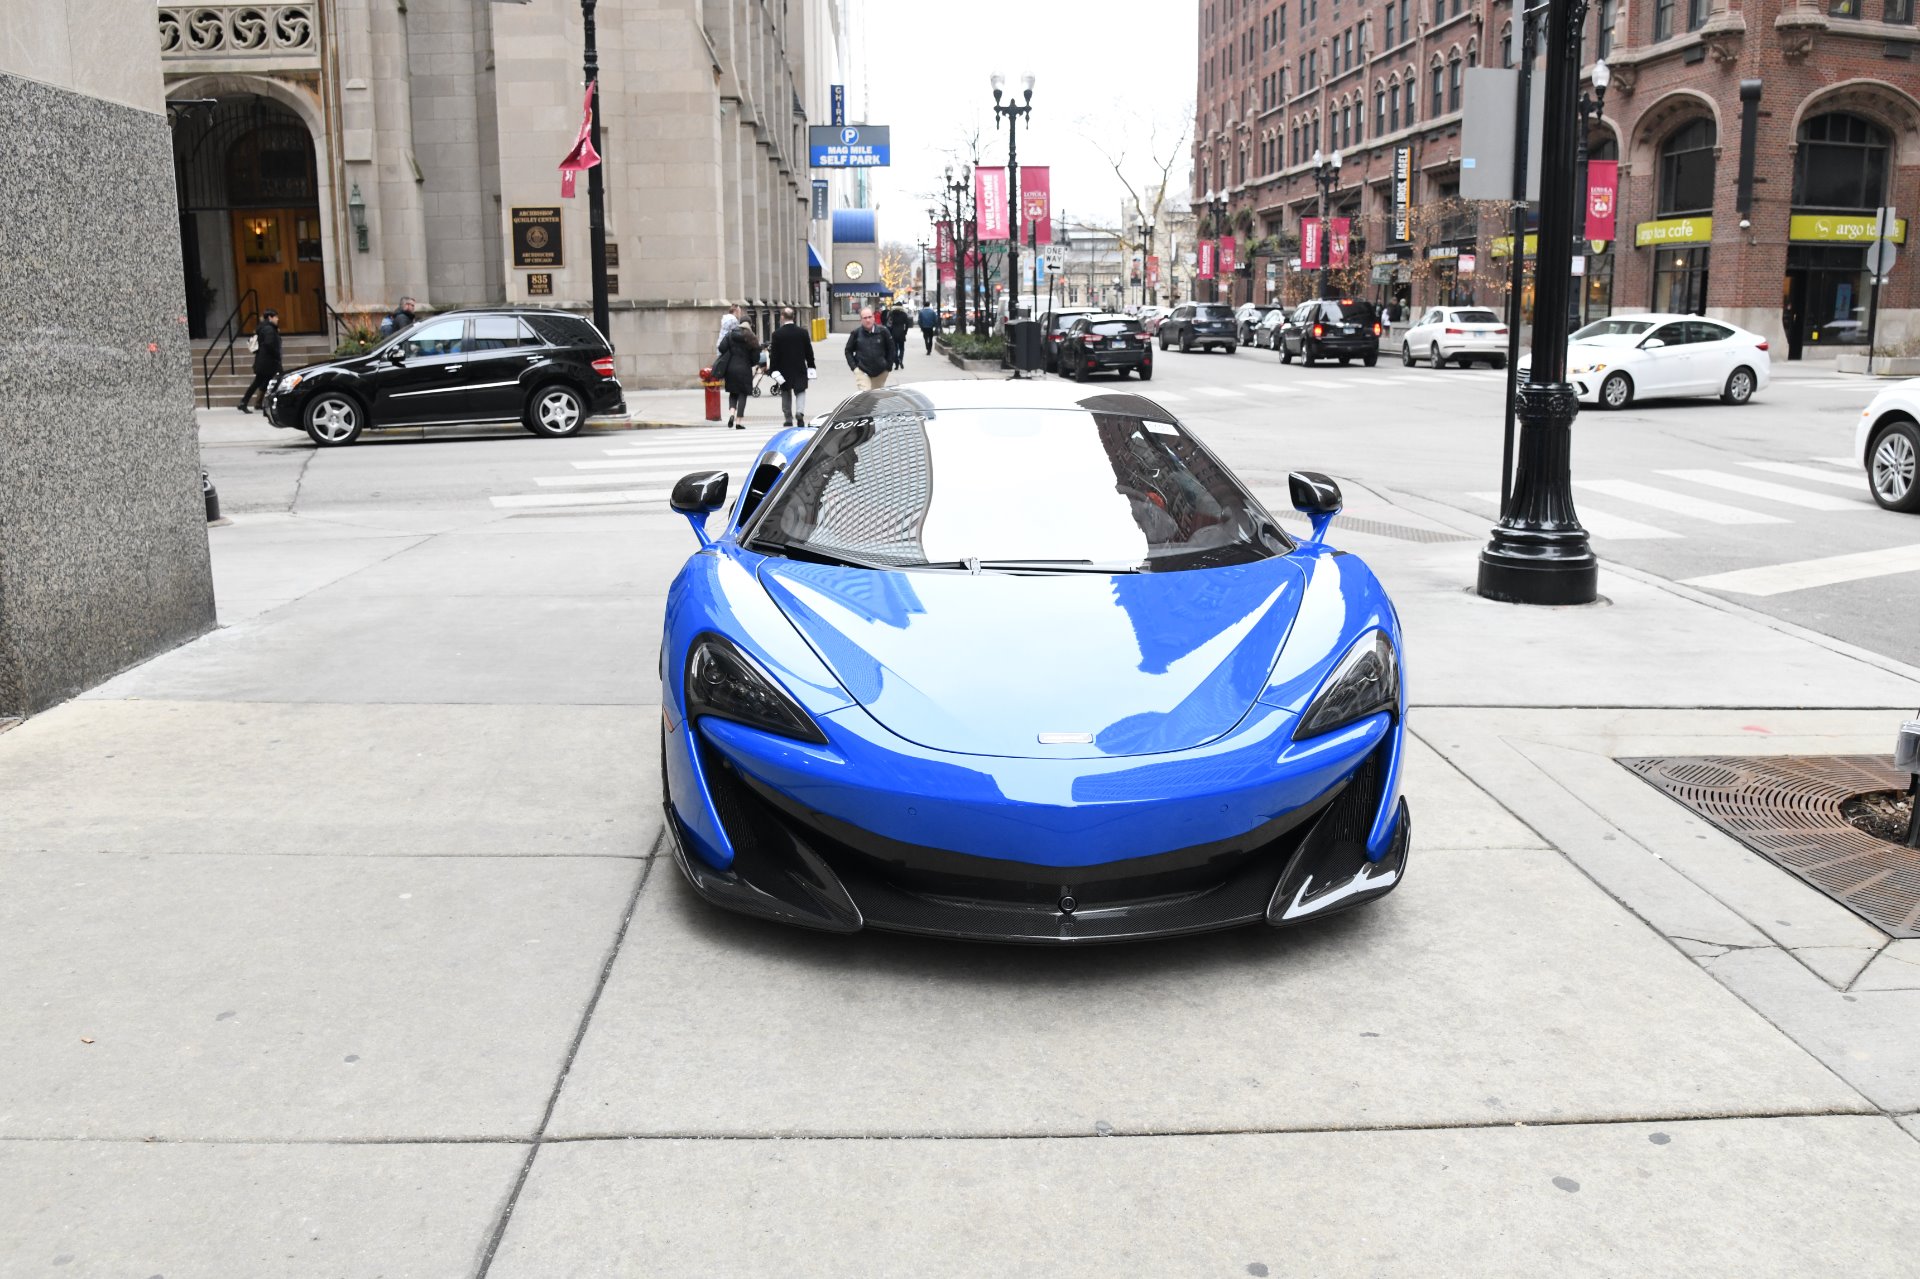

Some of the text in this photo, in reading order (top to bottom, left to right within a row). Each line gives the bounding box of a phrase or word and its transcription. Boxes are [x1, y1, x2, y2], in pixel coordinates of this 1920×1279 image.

[844, 129, 856, 143] P
[827, 146, 872, 154] MAG MILE
[819, 155, 880, 165] SELF PARK
[1397, 148, 1408, 180] BAGELS
[983, 174, 995, 230] WELCOME
[1654, 228, 1665, 238] tea
[1668, 220, 1693, 238] café
[1836, 224, 1864, 239] argo
[1046, 247, 1062, 255] ONE
[531, 275, 548, 284] 835
